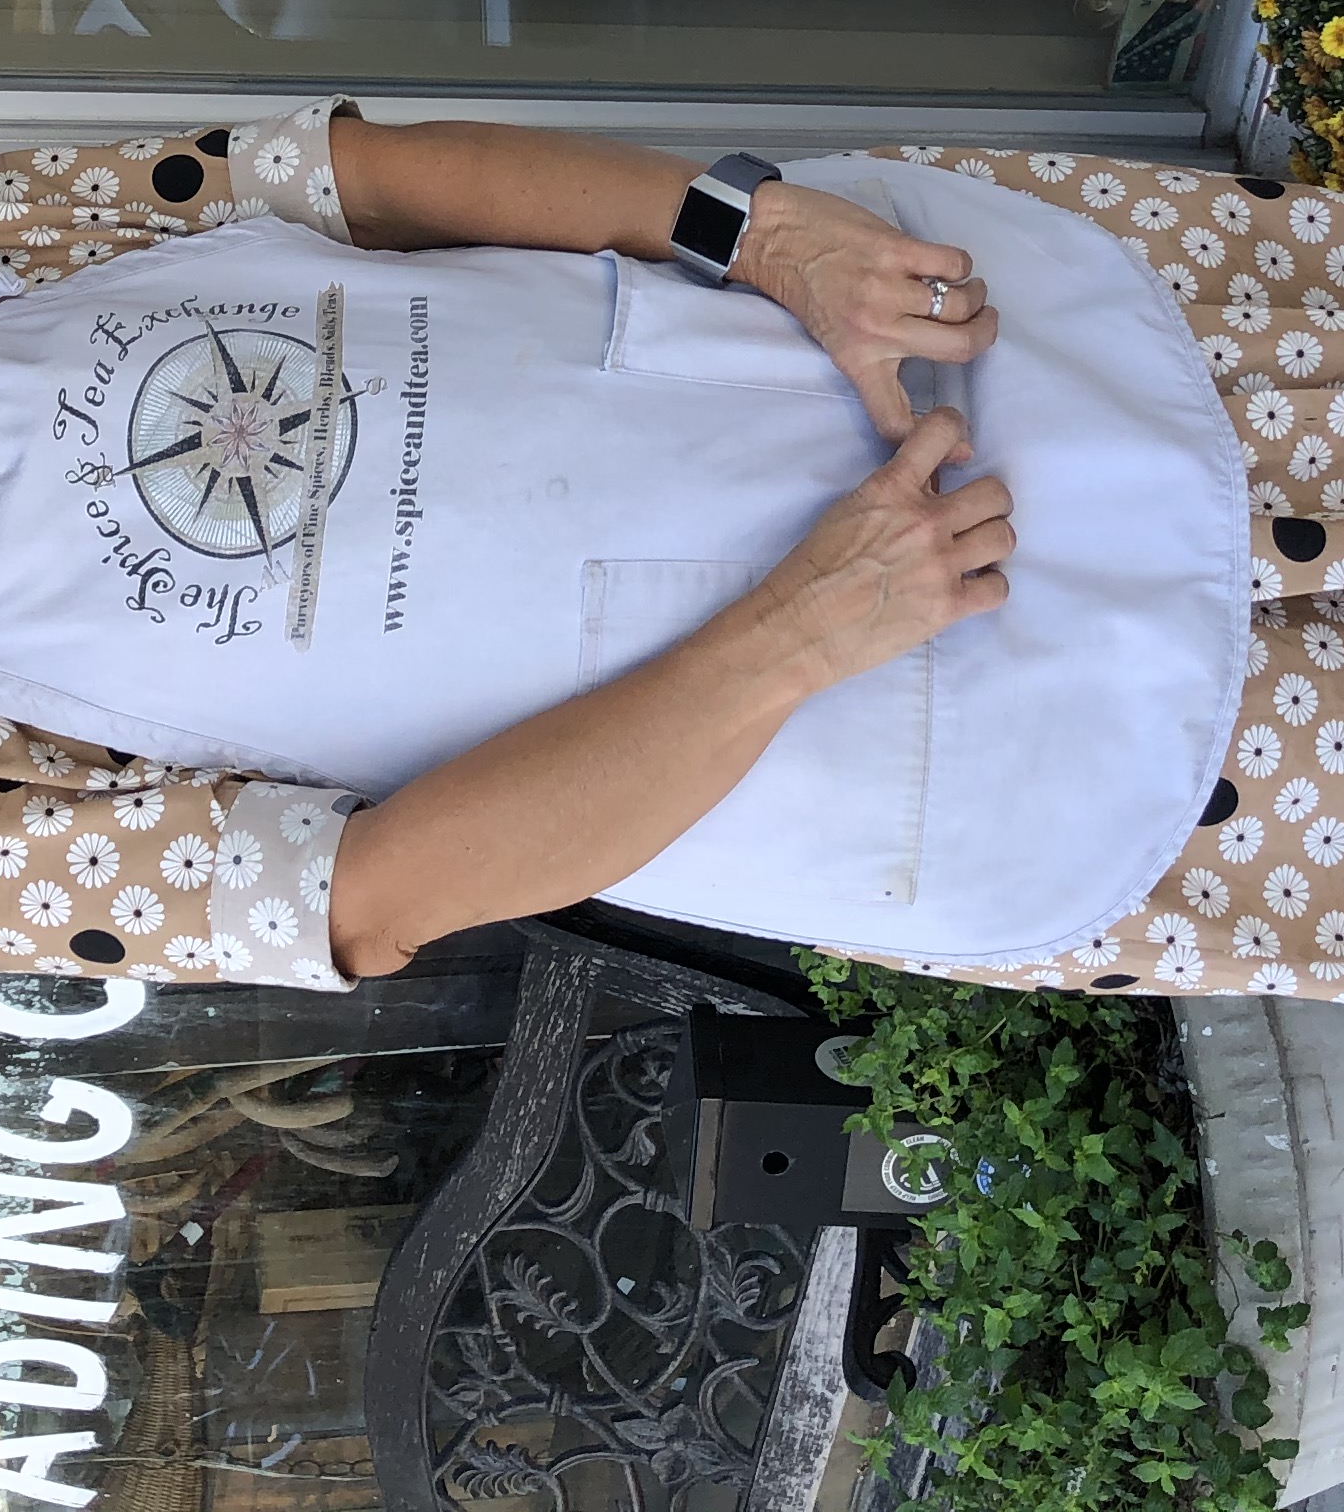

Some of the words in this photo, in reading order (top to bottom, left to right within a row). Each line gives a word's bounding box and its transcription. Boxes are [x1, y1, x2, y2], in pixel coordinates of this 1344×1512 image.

[88, 295, 302, 362] Exchange
[51, 362, 116, 447] Tea
[381, 295, 430, 634] www.spiceandtea.com
[78, 497, 175, 624] Spice
[289, 561, 315, 640] Purveyors
[302, 503, 320, 538] Fine
[175, 583, 265, 645] The
